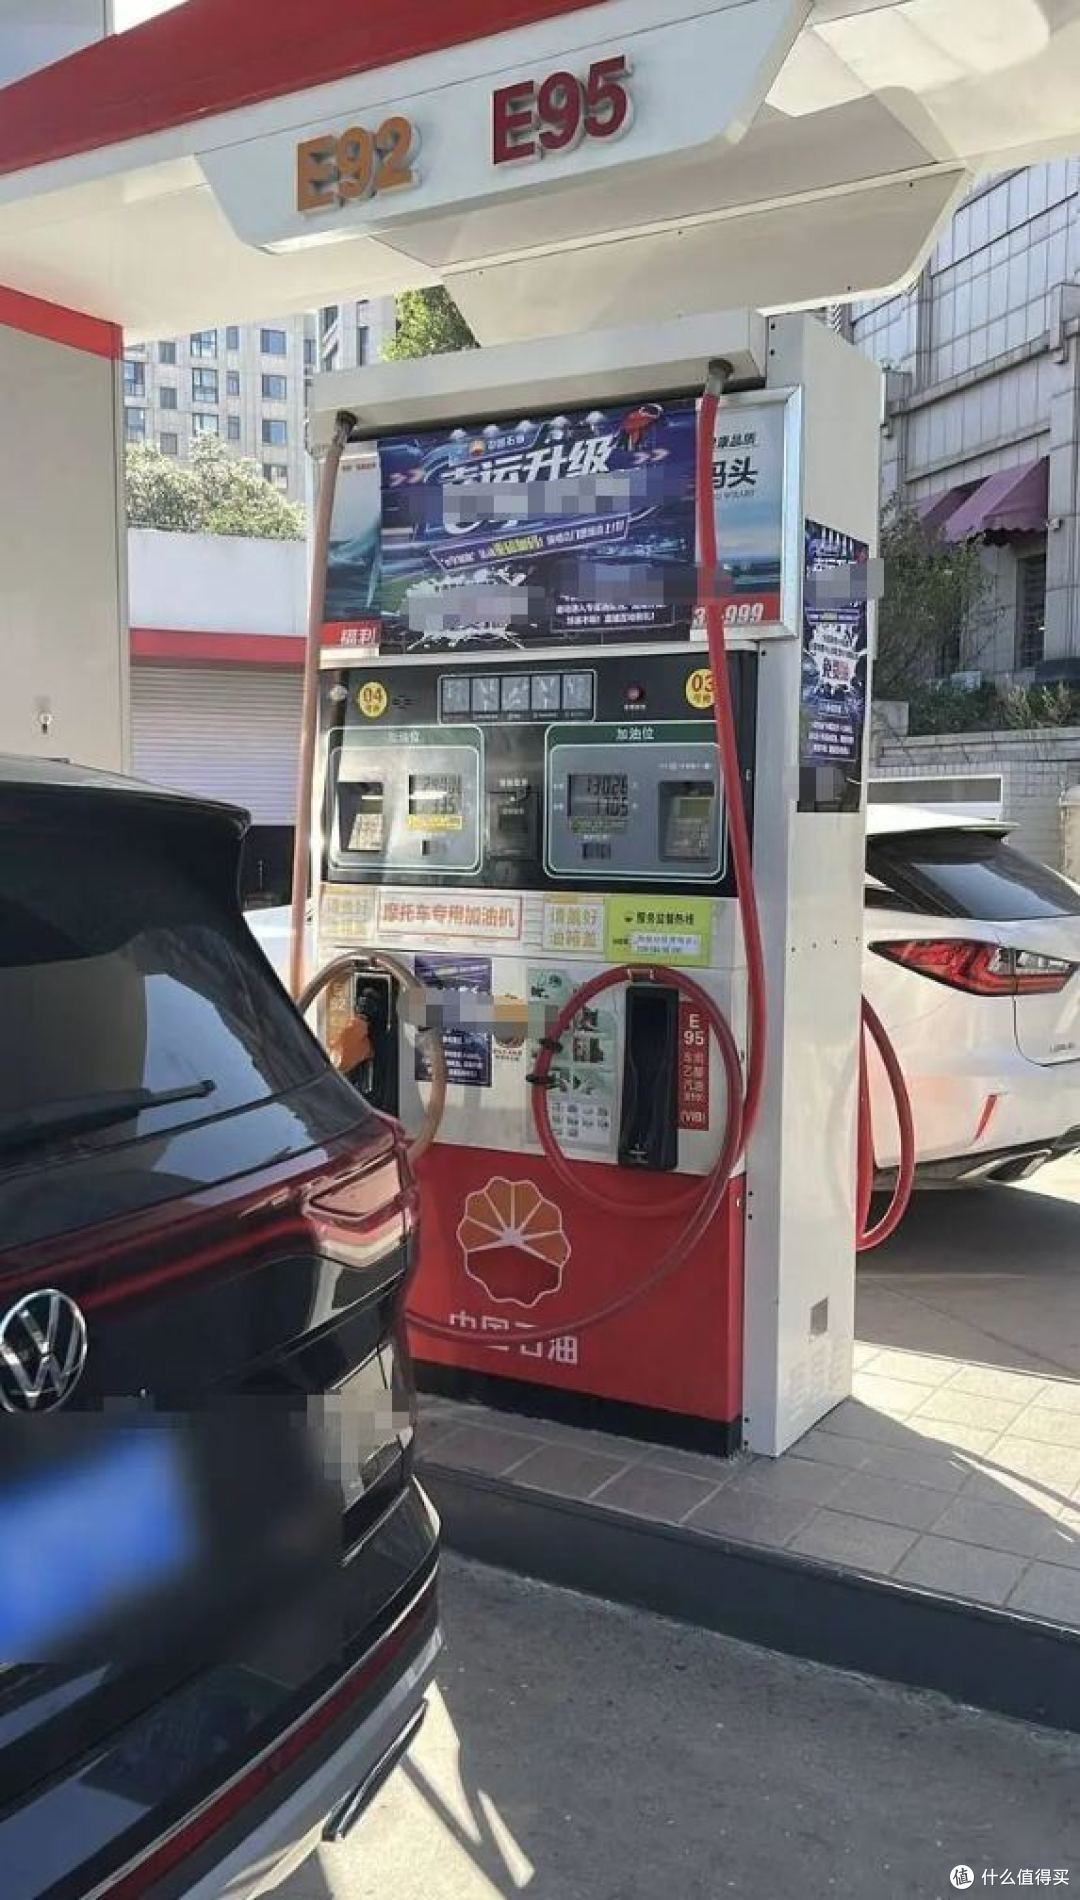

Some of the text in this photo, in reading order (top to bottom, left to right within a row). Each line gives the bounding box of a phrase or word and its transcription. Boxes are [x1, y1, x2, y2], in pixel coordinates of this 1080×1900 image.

[493, 55, 633, 166] E95
[296, 115, 418, 212] E92
[363, 687, 382, 703] 04
[616, 726, 655, 741] 加油位
[382, 902, 514, 928] 摩托车专用加油机
[636, 911, 695, 926] 服务监督热线
[689, 1013, 701, 1029] E
[683, 1030, 704, 1046] 95
